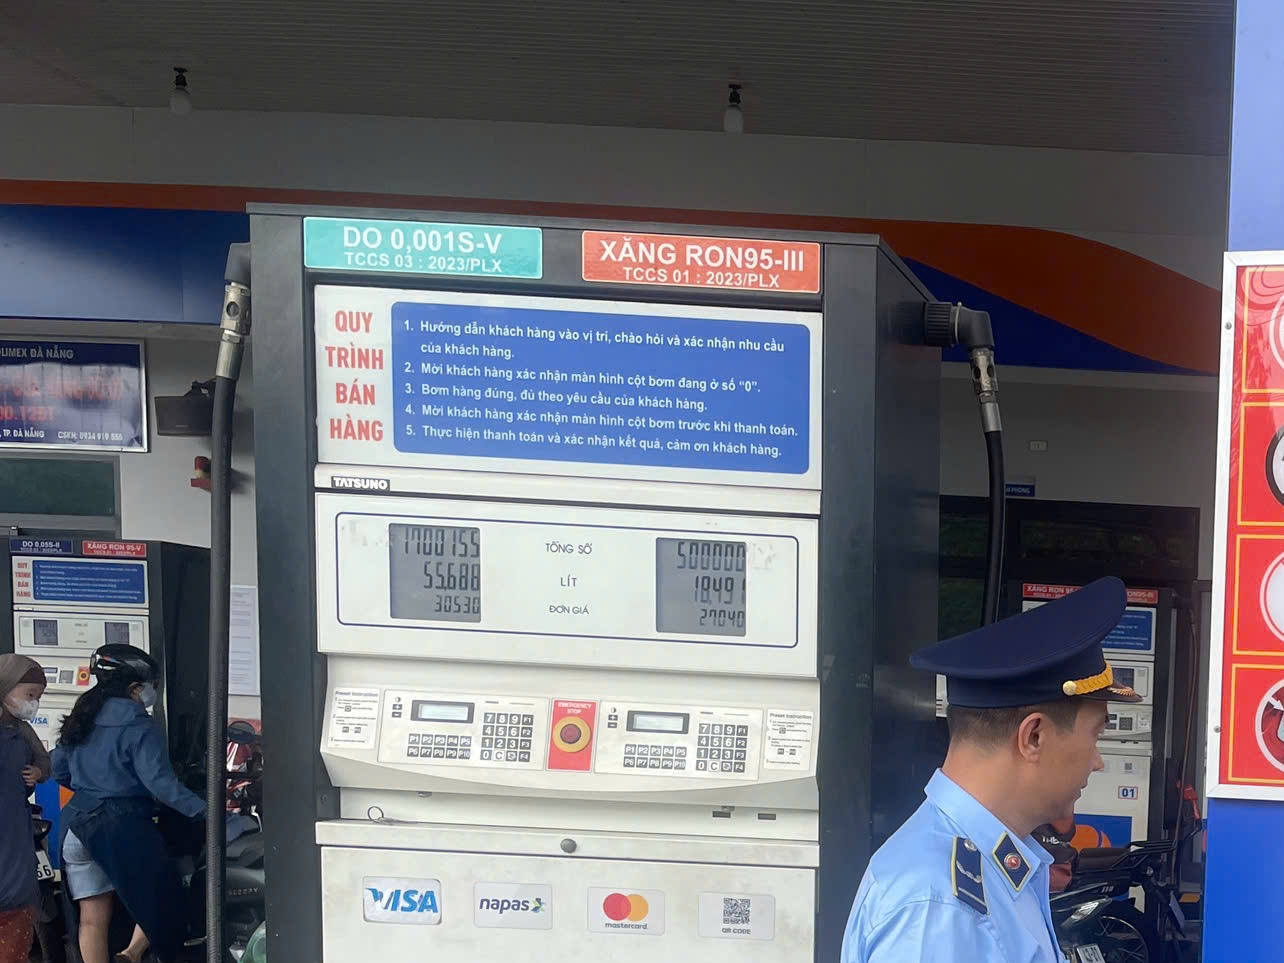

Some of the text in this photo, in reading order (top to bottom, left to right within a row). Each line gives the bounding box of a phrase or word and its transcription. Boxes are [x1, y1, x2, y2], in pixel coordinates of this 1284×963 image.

[343, 225, 502, 255] DO 0,001S-V
[344, 252, 389, 266] TCCS
[394, 254, 413, 268] 03
[600, 236, 804, 272] XĂNG RON95-III
[623, 266, 780, 288] TCCS 01 2023/PLX
[335, 310, 373, 333] QUY
[489, 322, 523, 337] khách
[738, 338, 761, 351] nhu
[325, 341, 384, 370] TRÌNH
[444, 343, 480, 356] khách
[446, 364, 481, 378] khách
[335, 378, 376, 405] BÁN
[538, 388, 564, 403] theo
[638, 395, 673, 410] khách
[330, 413, 384, 441] HÀNG
[333, 477, 388, 490] TATSUNO
[560, 574, 577, 588] LÍT
[572, 603, 589, 615] GIÁ
[1122, 789, 1135, 798] 01
[366, 888, 439, 914] VISA
[479, 898, 530, 915] napas
[605, 922, 648, 930] mastercard
[721, 927, 732, 935] QR
